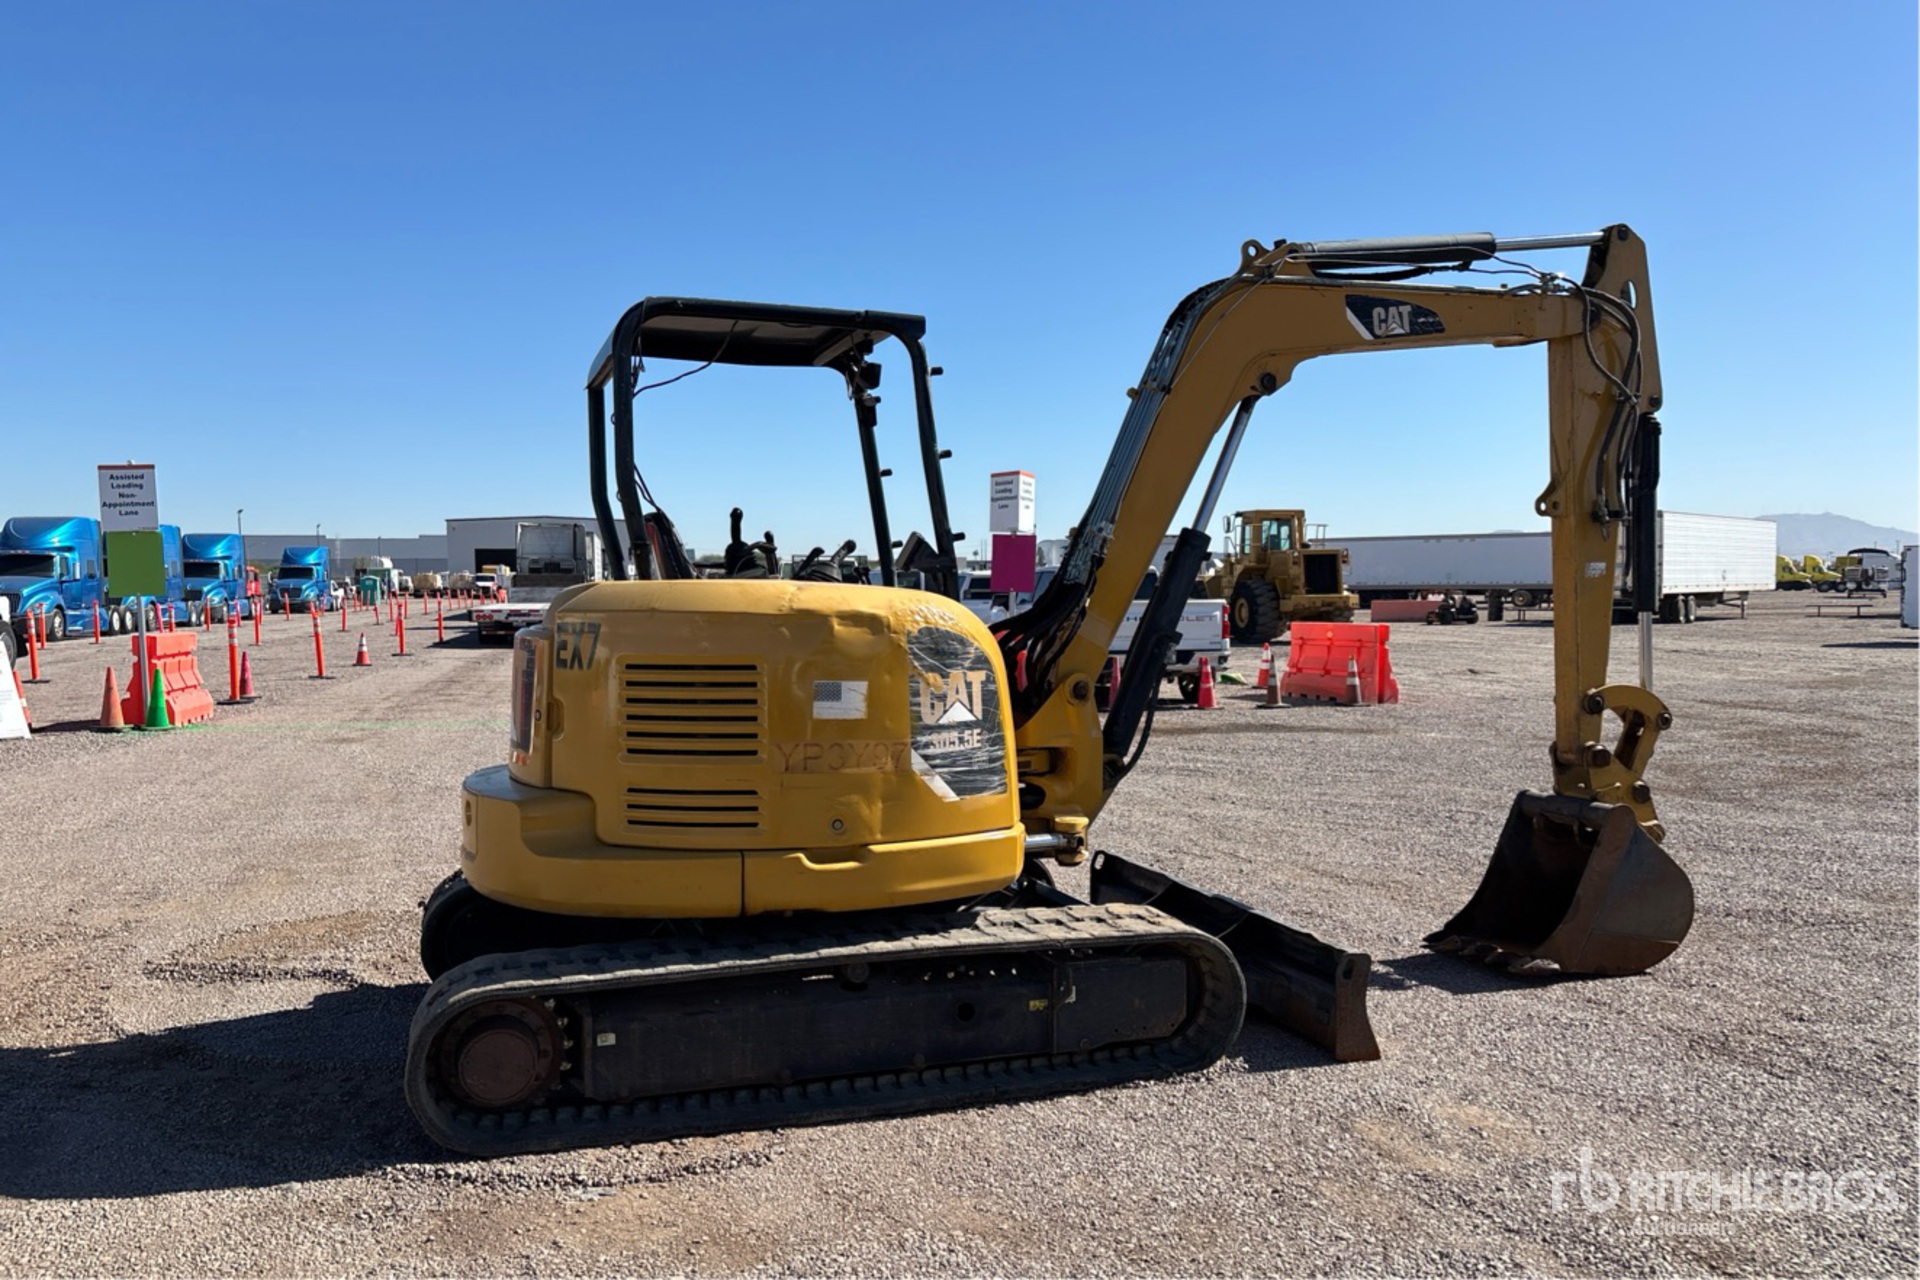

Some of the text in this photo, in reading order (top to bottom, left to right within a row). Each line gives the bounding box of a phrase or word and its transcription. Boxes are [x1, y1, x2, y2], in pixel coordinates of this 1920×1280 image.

[1372, 305, 1411, 337] CAT
[102, 501, 155, 509] Appointment
[556, 622, 601, 671] EX7
[920, 670, 986, 724] CAT
[930, 729, 982, 749] 305.5E
[776, 742, 908, 773] YP3Y97
